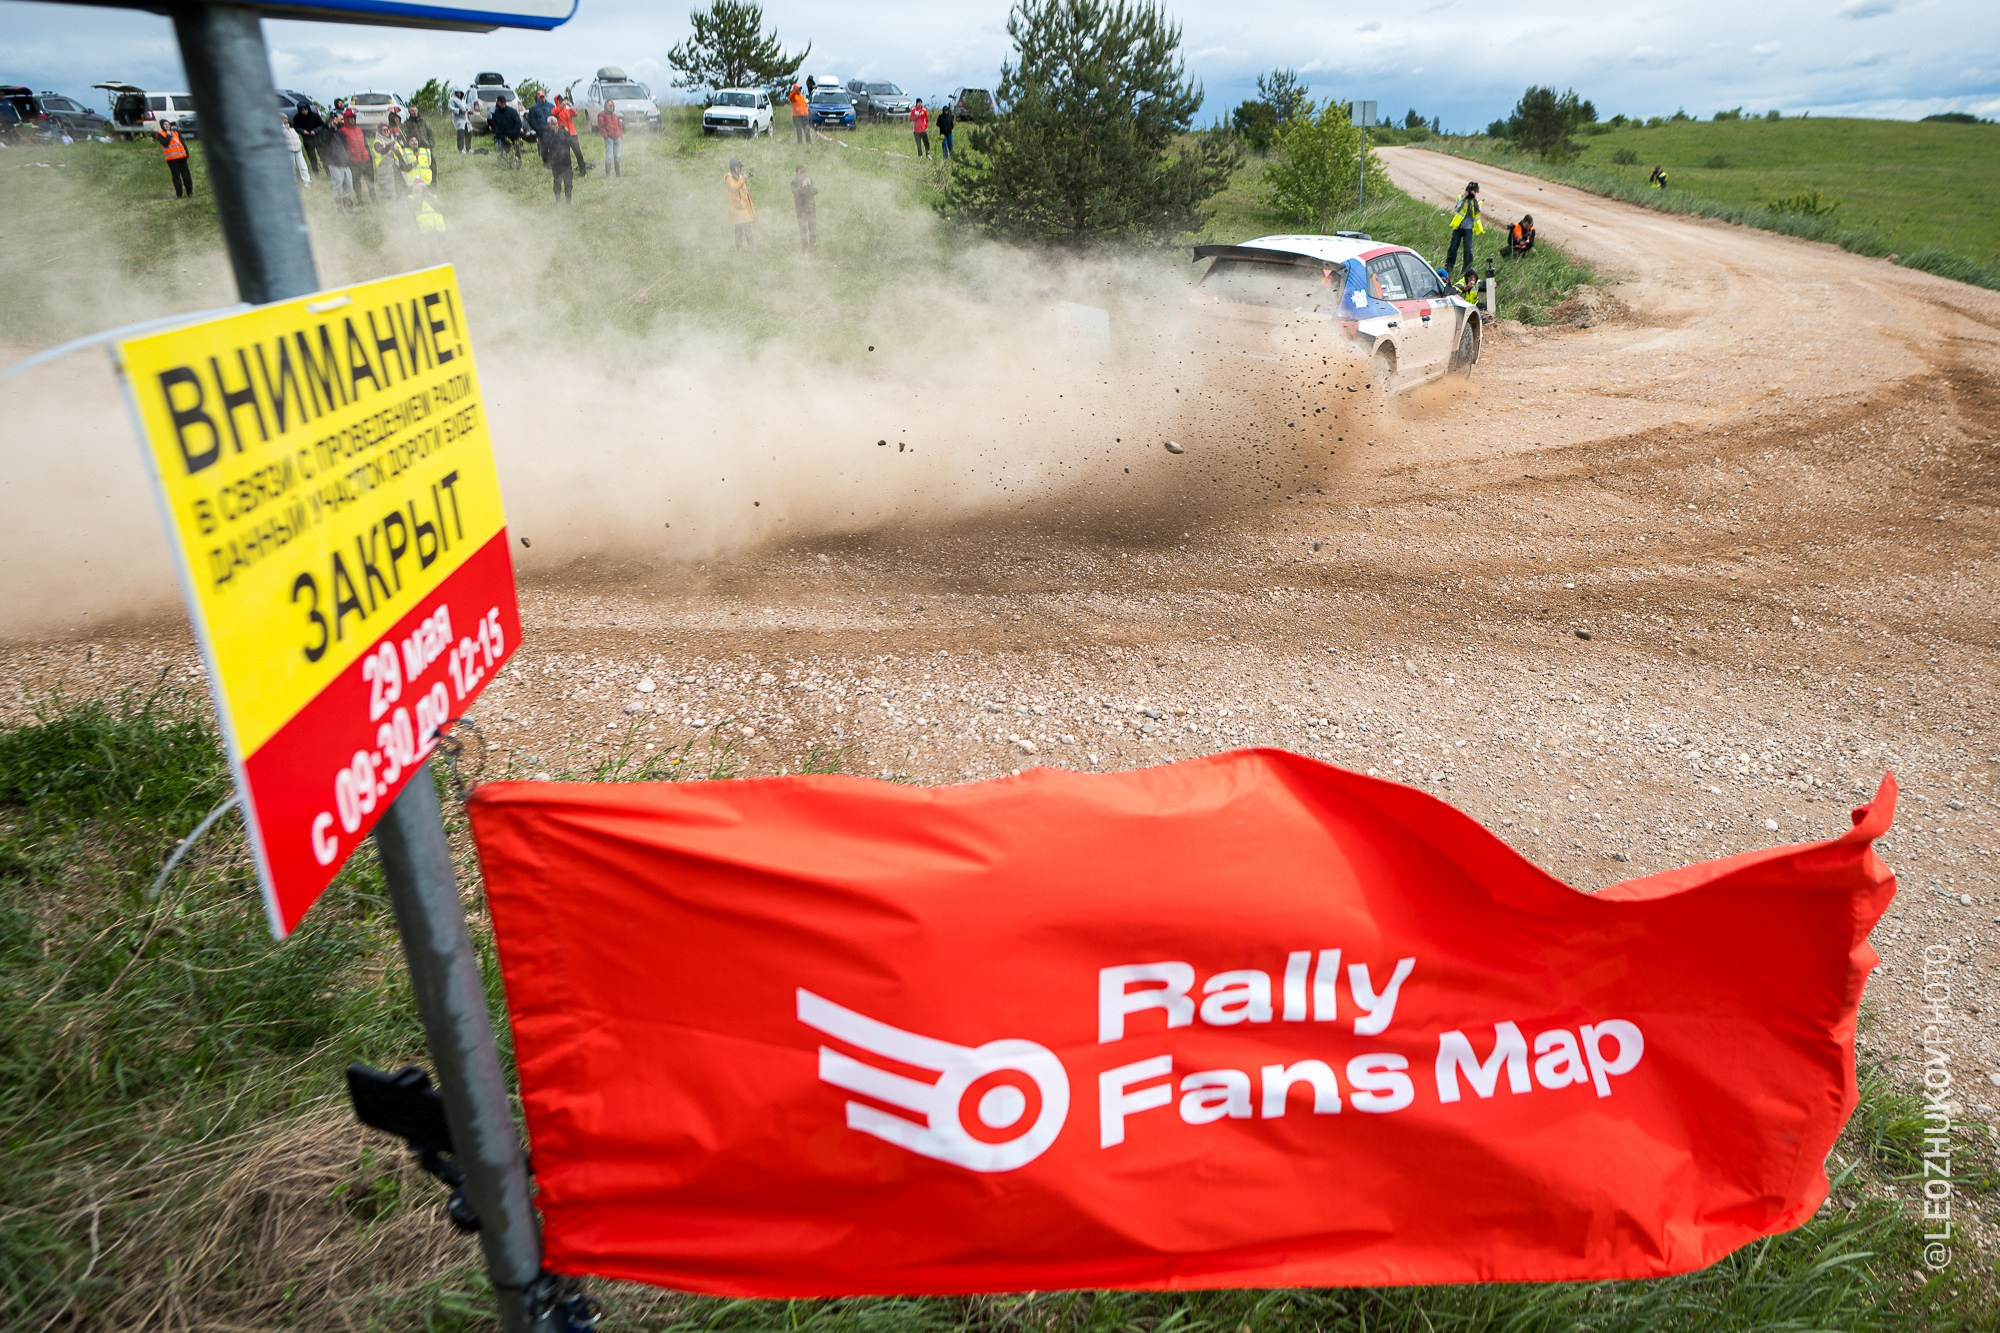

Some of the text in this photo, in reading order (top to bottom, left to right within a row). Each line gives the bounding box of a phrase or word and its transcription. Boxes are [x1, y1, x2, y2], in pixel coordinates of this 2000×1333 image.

[156, 289, 464, 475] ВНИМАНИЕ!
[193, 498, 219, 537] В
[218, 456, 296, 521] СВЯЗИ
[315, 391, 431, 471] ПРОВЕДЕНИЕМ
[209, 403, 478, 588] ДАННЫЙ УЧАСТОК ДОРОГИ БУДЕТ
[291, 469, 466, 663] ЗАКРЫТ
[335, 706, 414, 834] 09:30
[412, 681, 450, 762] до
[449, 606, 504, 701] 12:15
[362, 604, 454, 722] 29 мая
[1098, 948, 1416, 1044] Rally
[1099, 1017, 1645, 1149] Fans Map
